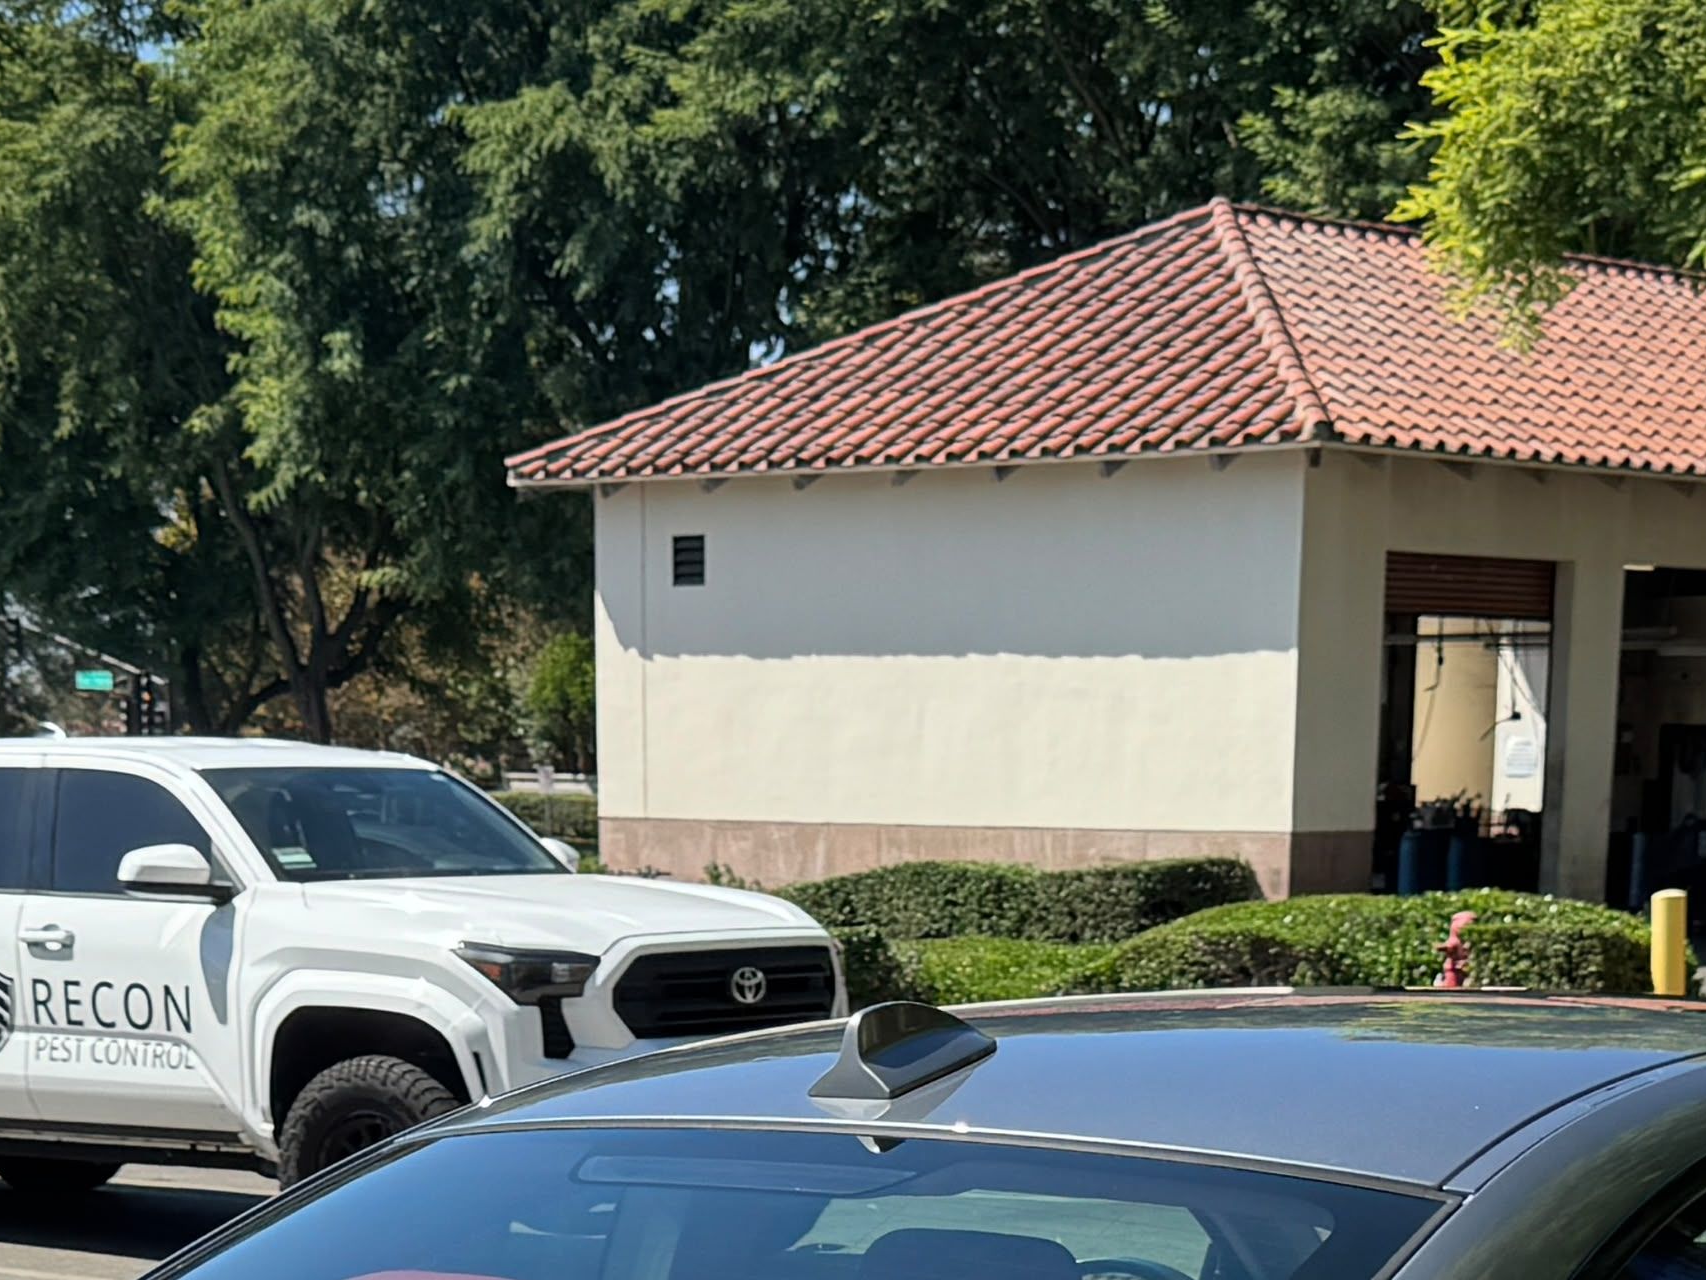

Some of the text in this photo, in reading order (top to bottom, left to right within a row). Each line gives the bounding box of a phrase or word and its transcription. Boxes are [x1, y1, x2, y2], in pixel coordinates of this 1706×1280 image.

[31, 978, 192, 1034] RECON
[35, 1036, 196, 1070] PEST CONTROL
